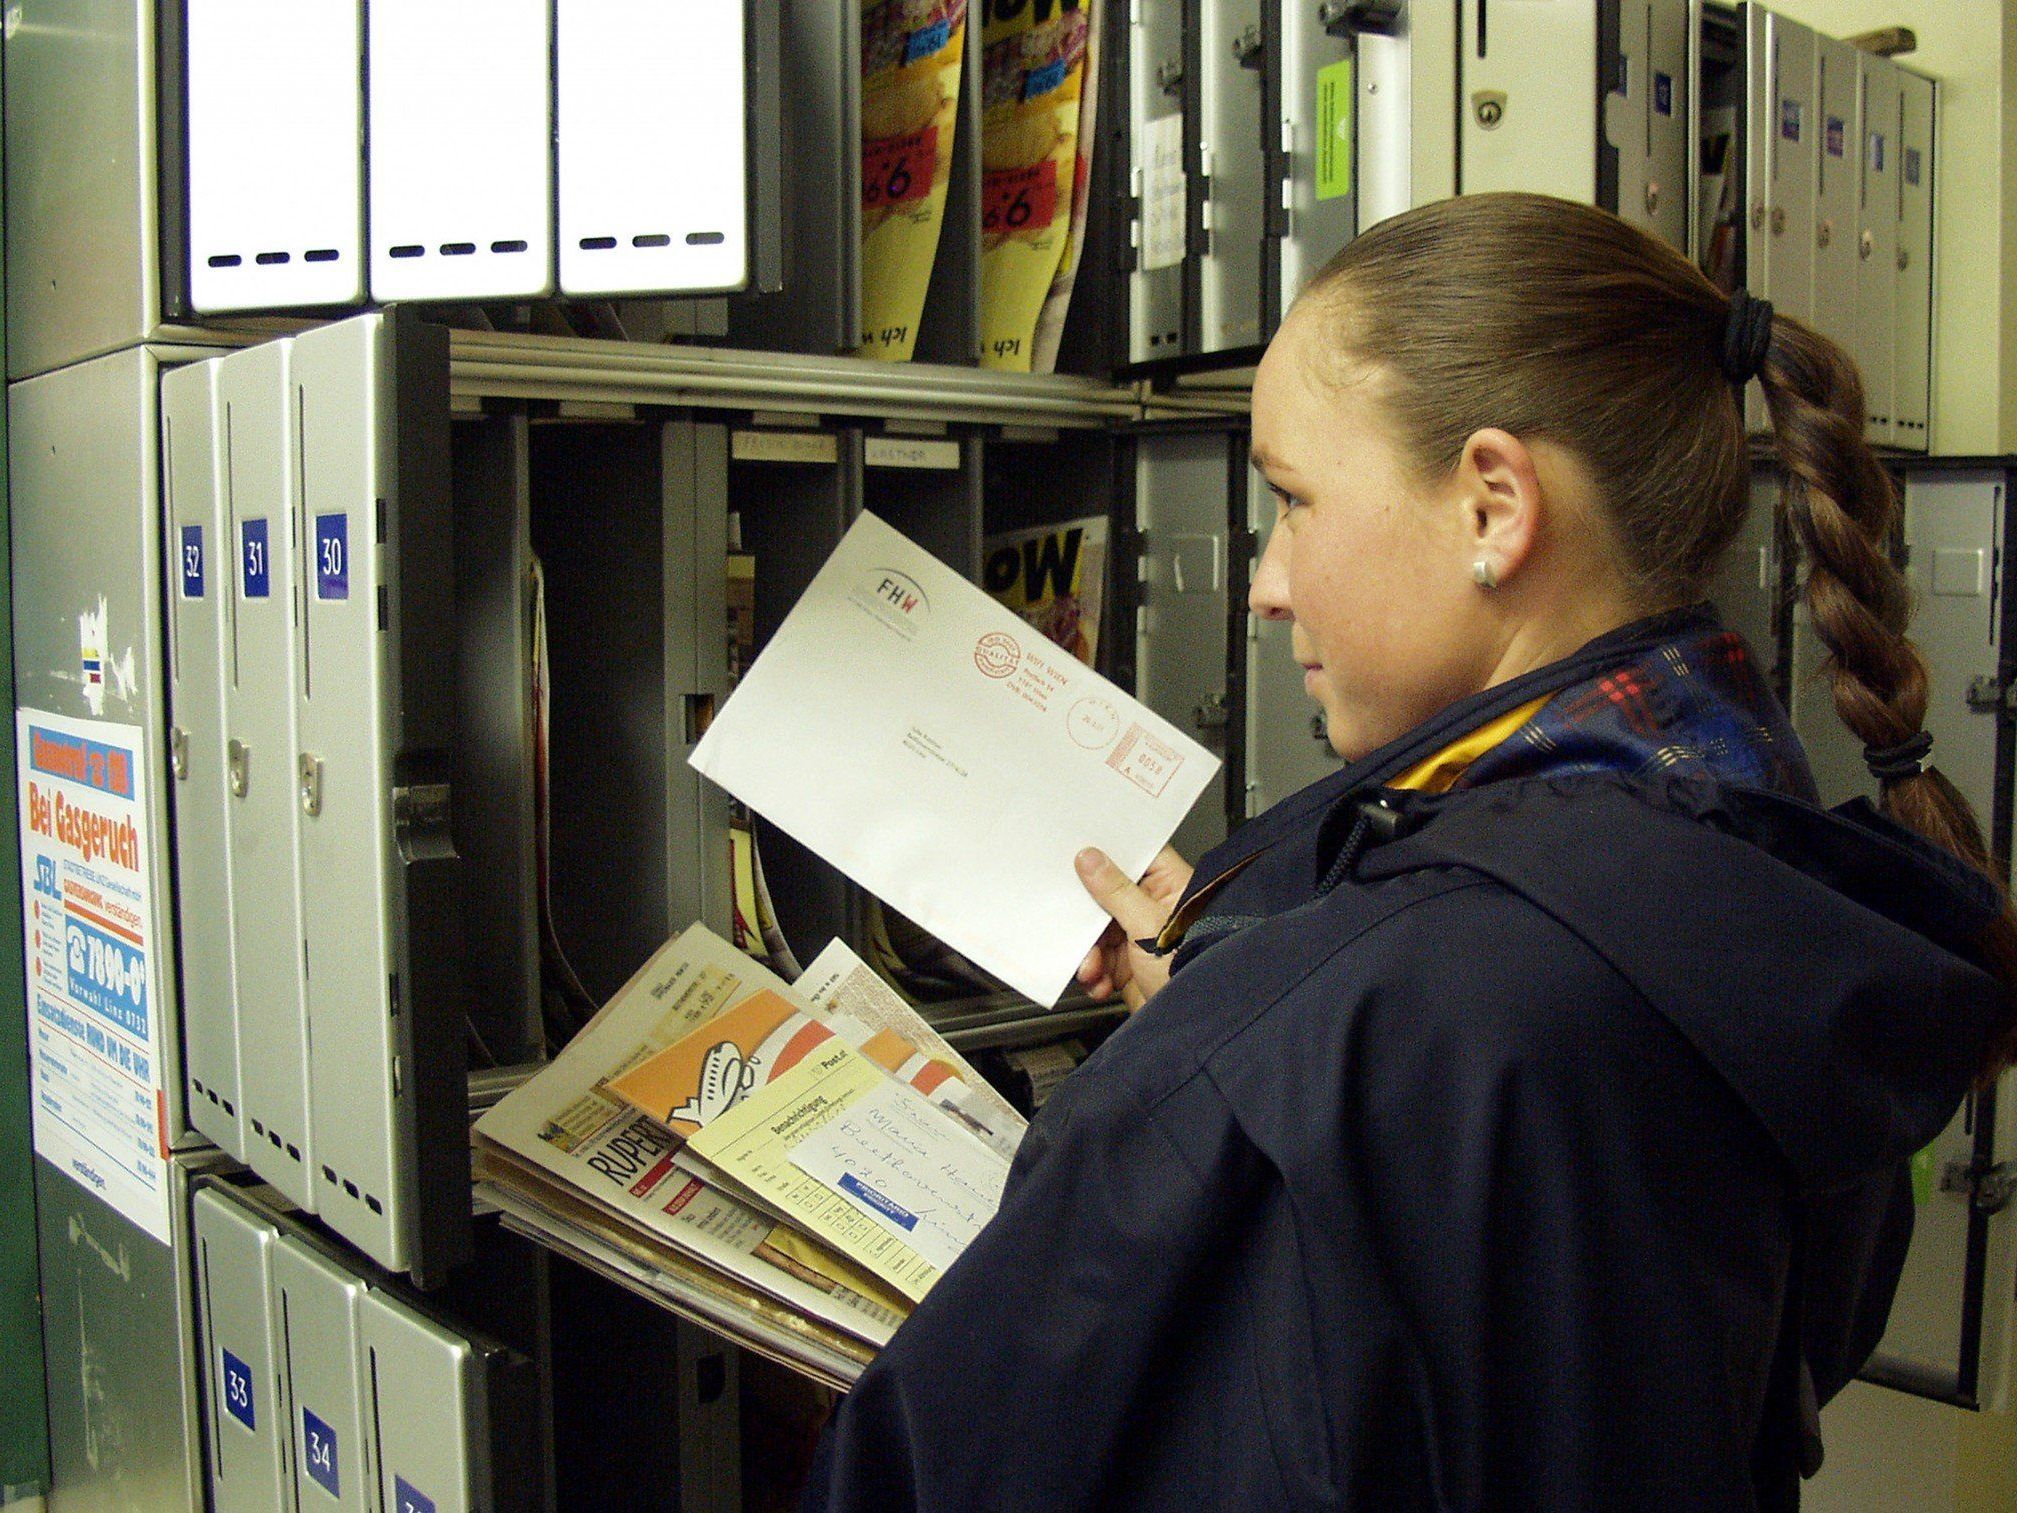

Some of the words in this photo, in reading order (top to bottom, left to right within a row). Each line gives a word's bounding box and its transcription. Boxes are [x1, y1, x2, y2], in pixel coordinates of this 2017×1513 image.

[881, 326, 907, 347] Ich
[994, 339, 1020, 358] Ich
[186, 545, 200, 578] 32
[248, 541, 264, 576] 31
[322, 538, 342, 576] 30
[876, 577, 918, 615] FHW
[30, 781, 52, 837] Bei
[55, 789, 139, 872] Gasgeruch
[69, 976, 102, 1005] Vorwahl
[104, 996, 122, 1019] Linz
[125, 1008, 147, 1034] 0732
[770, 1094, 828, 1135] Benachrichtigung
[831, 1145, 888, 1189] 4020
[230, 1370, 248, 1407] 33
[311, 1432, 331, 1473] 34
